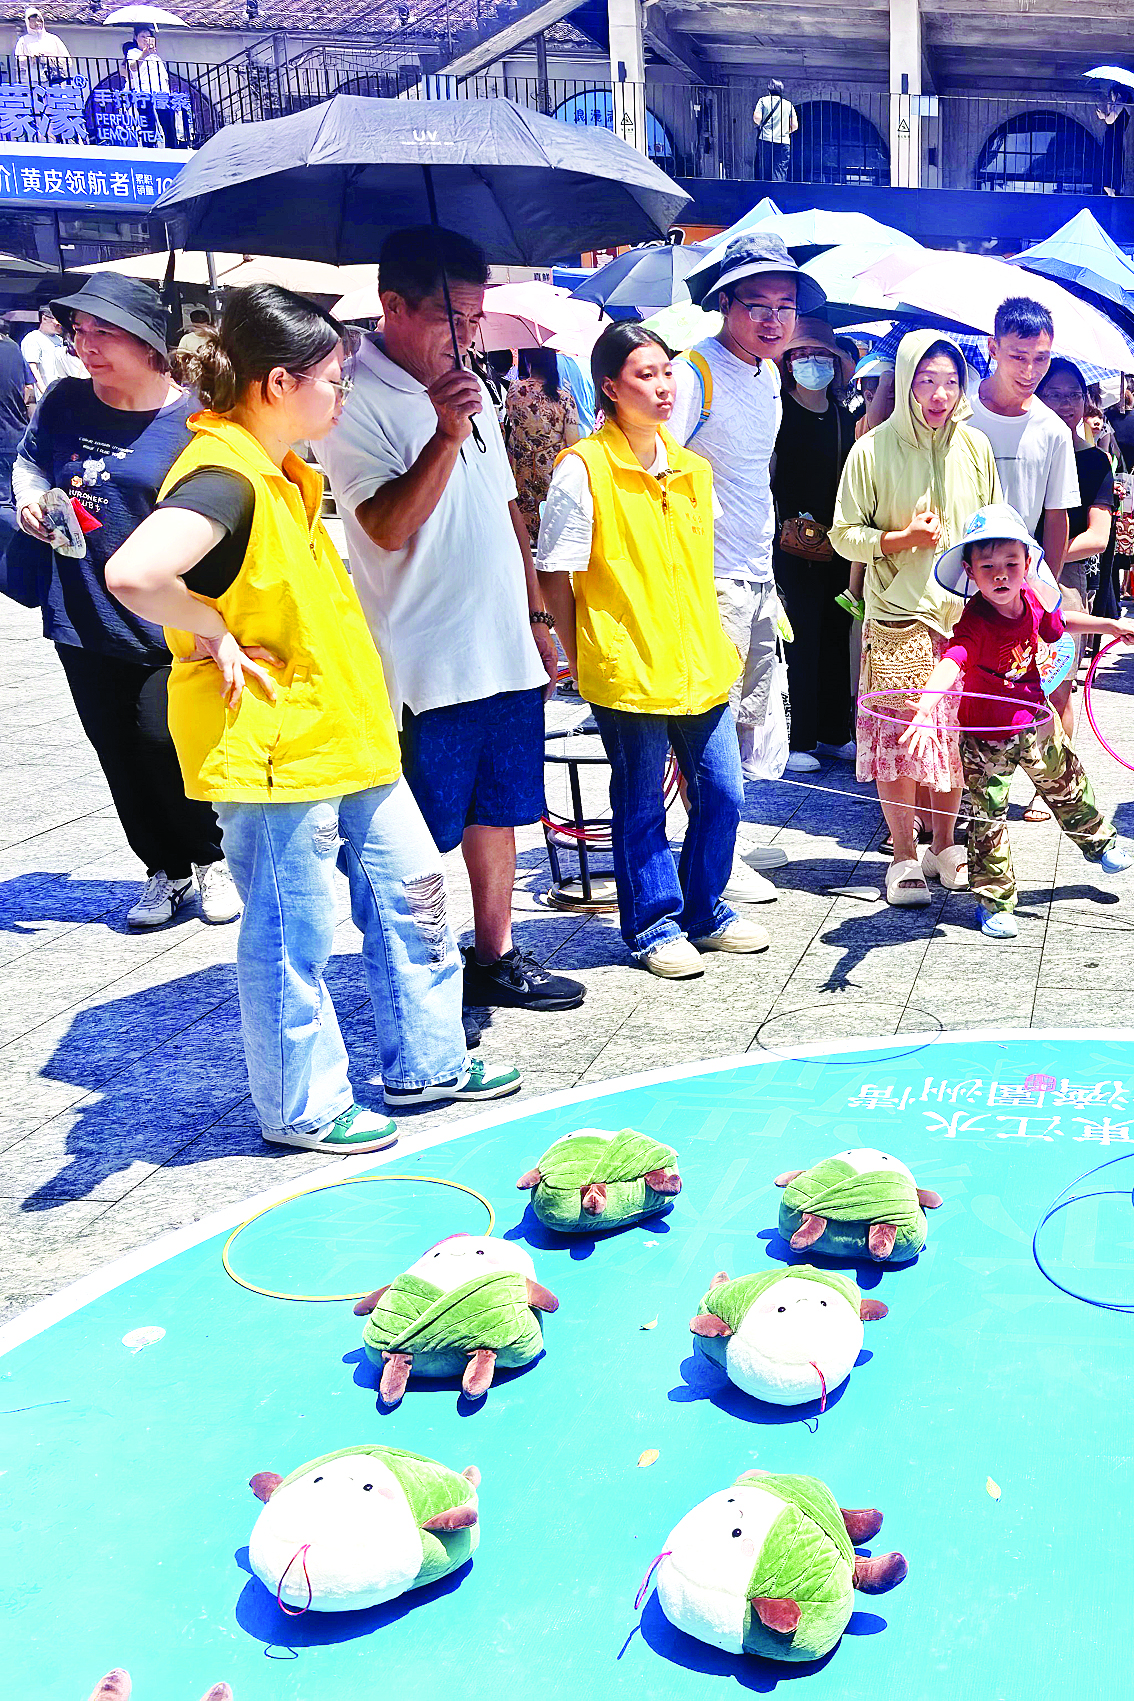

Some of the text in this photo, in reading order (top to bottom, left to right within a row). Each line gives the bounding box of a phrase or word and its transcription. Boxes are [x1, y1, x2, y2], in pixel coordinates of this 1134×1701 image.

[95, 112, 148, 128] PERFUME
[97, 126, 165, 144] LEMON TEA
[413, 129, 438, 142] UV
[20, 167, 130, 197] 黄皮领航者
